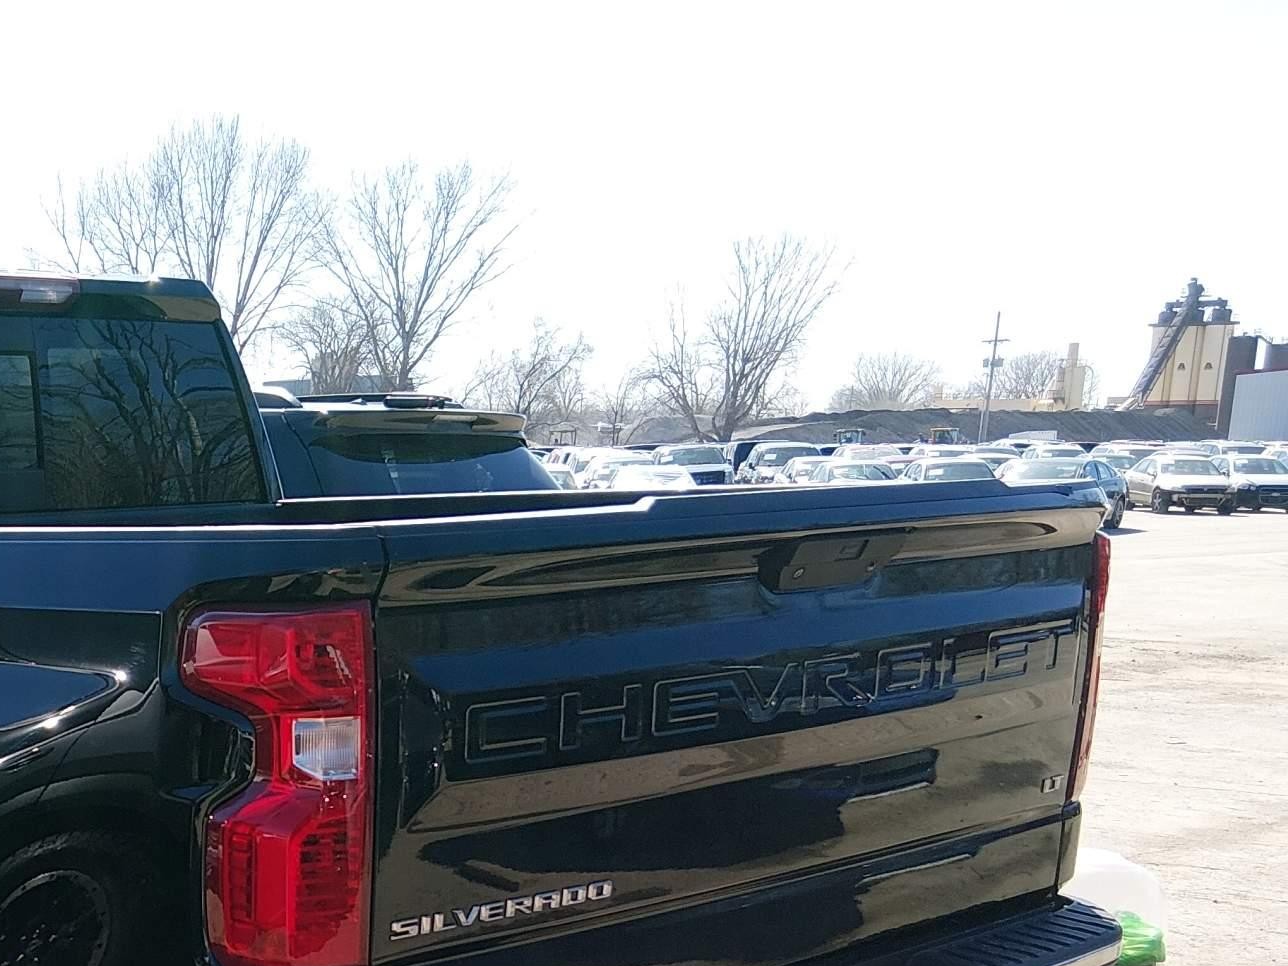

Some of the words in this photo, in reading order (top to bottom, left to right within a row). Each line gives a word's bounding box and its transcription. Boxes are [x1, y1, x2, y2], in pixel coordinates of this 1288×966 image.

[464, 618, 1075, 765] CHEVROLET
[1041, 774, 1065, 794] LT
[390, 879, 613, 941] SILVERADO
